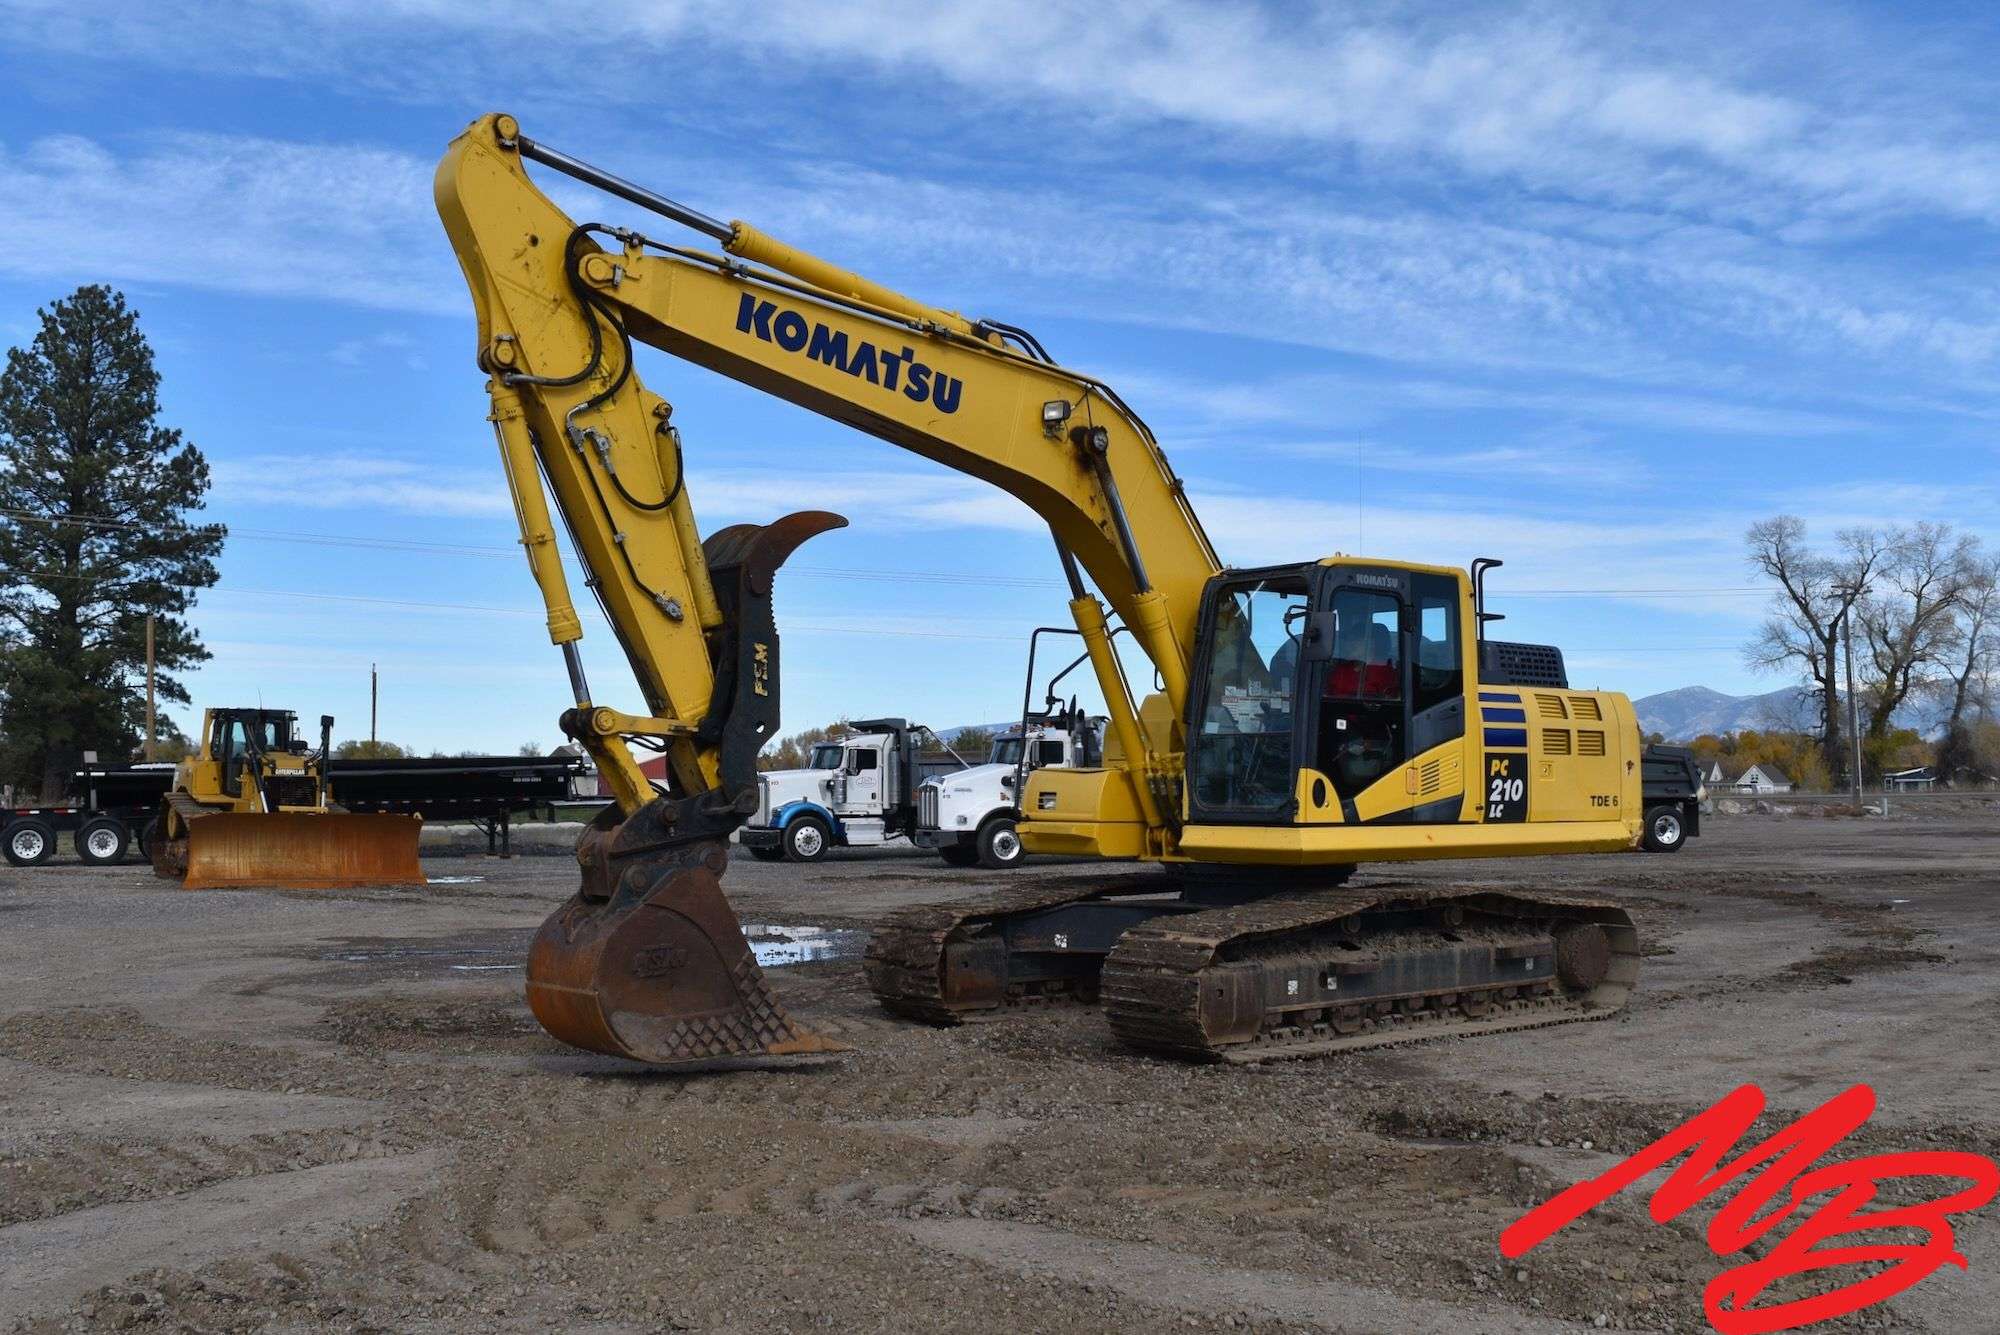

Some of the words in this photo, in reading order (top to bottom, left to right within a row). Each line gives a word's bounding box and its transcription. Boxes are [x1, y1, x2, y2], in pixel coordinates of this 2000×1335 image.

[736, 292, 962, 414] KOMATSU
[1356, 574, 1399, 588] KOMATSU
[1490, 759, 1509, 777] PC
[1489, 779, 1523, 801] 210
[1590, 795, 1610, 807] TDE
[1612, 795, 1619, 807] 6
[1488, 804, 1504, 818] LC
